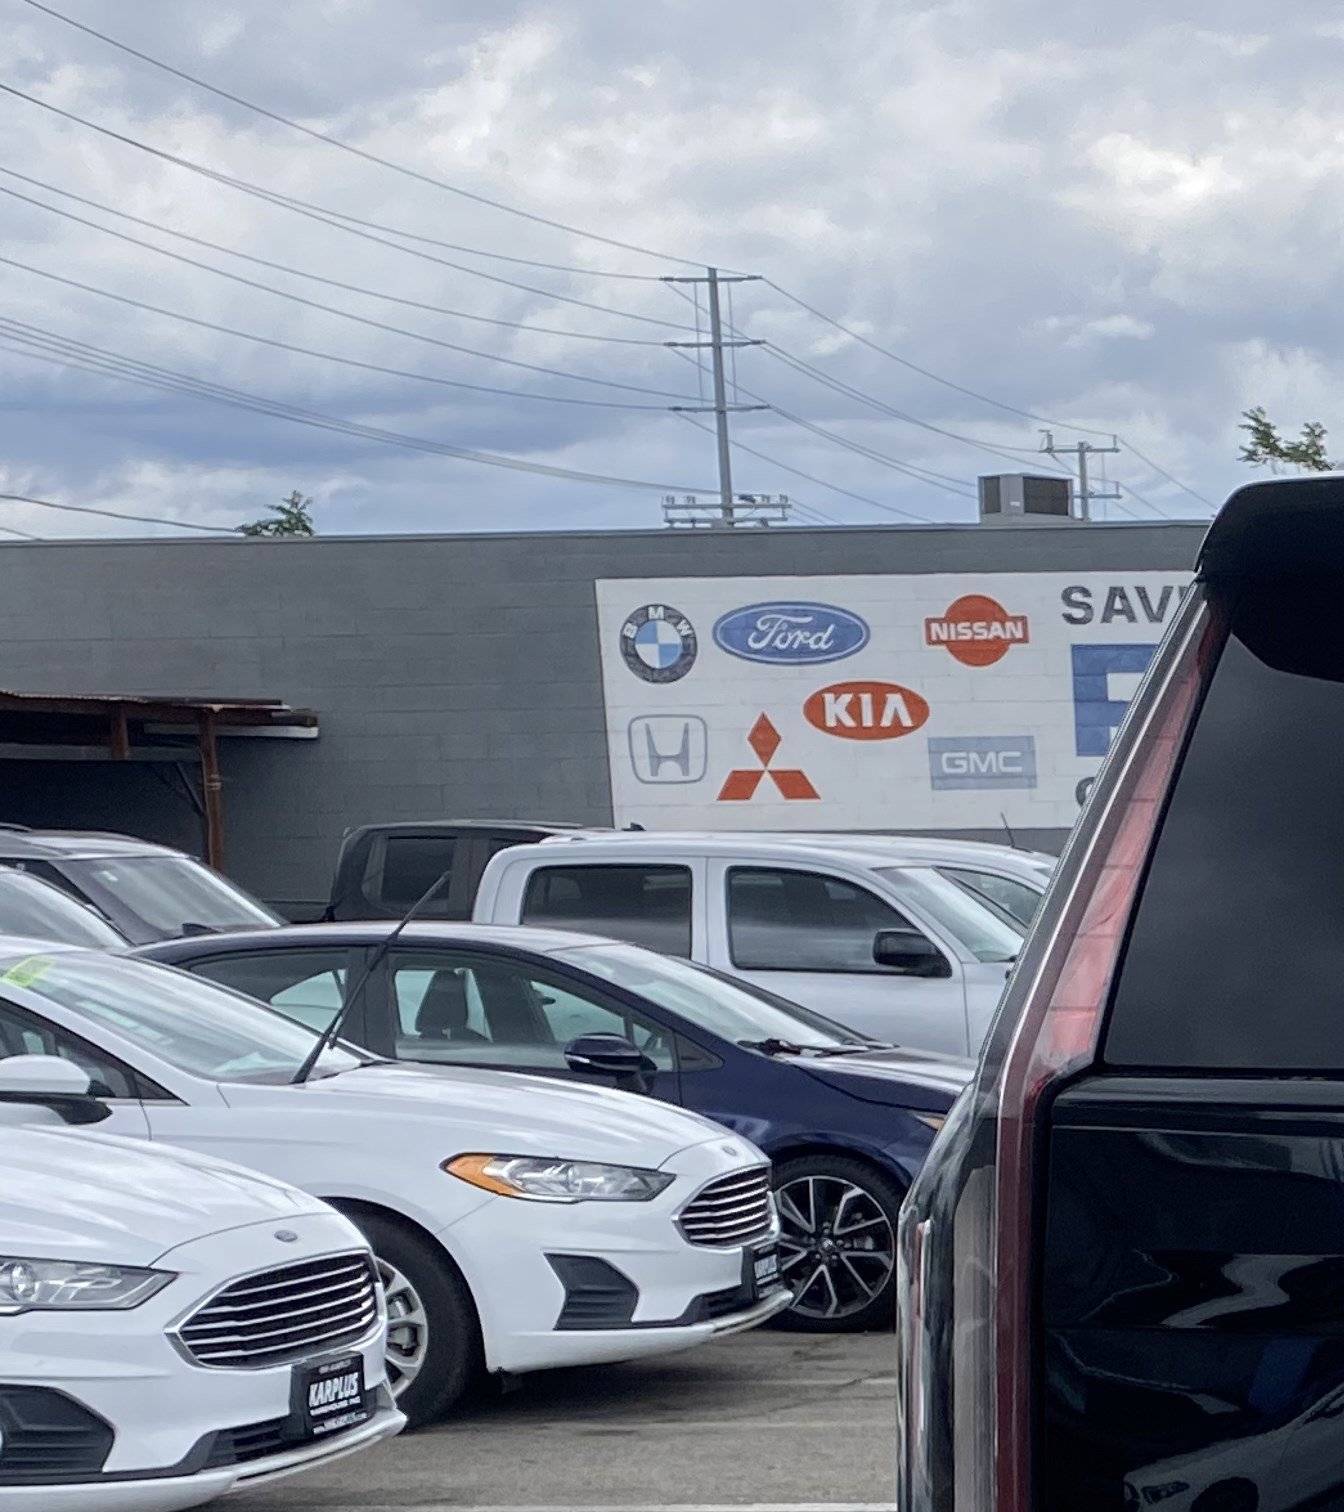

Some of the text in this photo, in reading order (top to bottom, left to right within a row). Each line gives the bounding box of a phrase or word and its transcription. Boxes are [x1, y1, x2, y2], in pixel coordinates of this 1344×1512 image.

[621, 605, 693, 640] BMW
[1060, 585, 1190, 625] SAV
[747, 613, 836, 652] Ford
[930, 620, 1024, 642] NISSAN
[821, 692, 914, 728] KIA
[940, 751, 1023, 775] GMC
